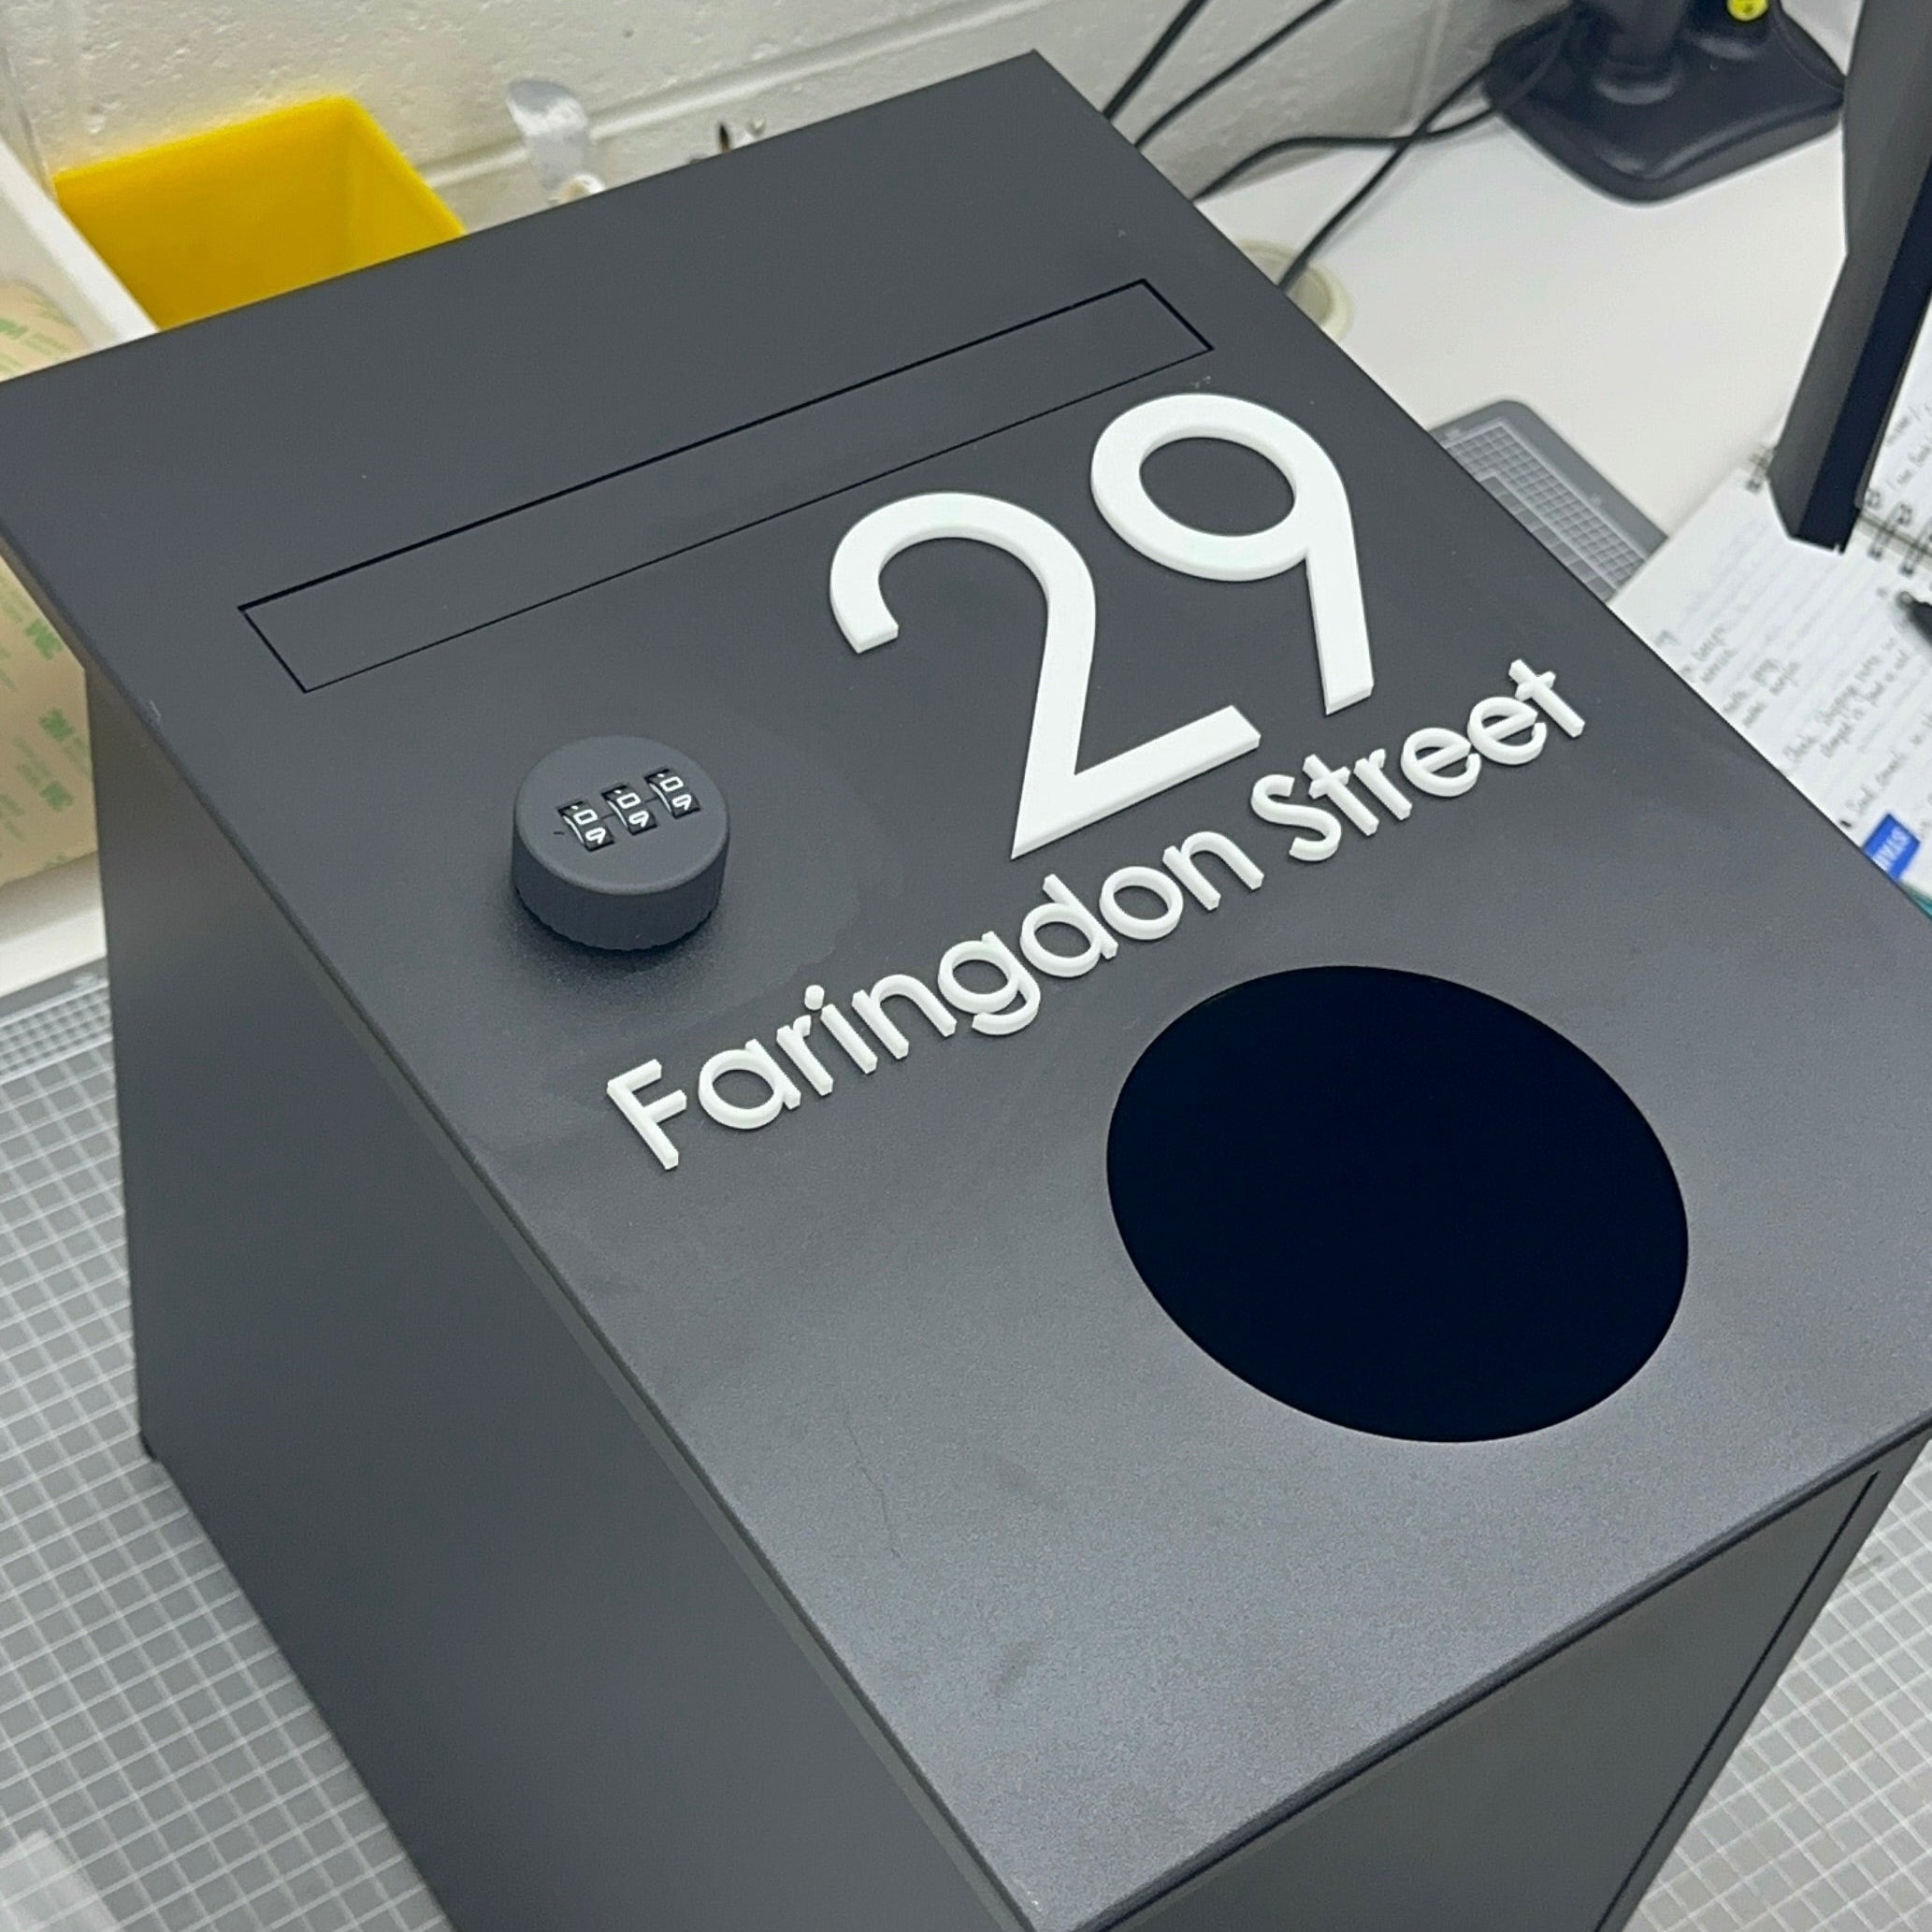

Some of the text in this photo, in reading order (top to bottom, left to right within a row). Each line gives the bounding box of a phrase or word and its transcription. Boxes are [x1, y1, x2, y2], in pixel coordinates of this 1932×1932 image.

[830, 394, 1374, 858] 29
[607, 831, 1265, 1170] Faringdon
[1251, 659, 1586, 861] Street
